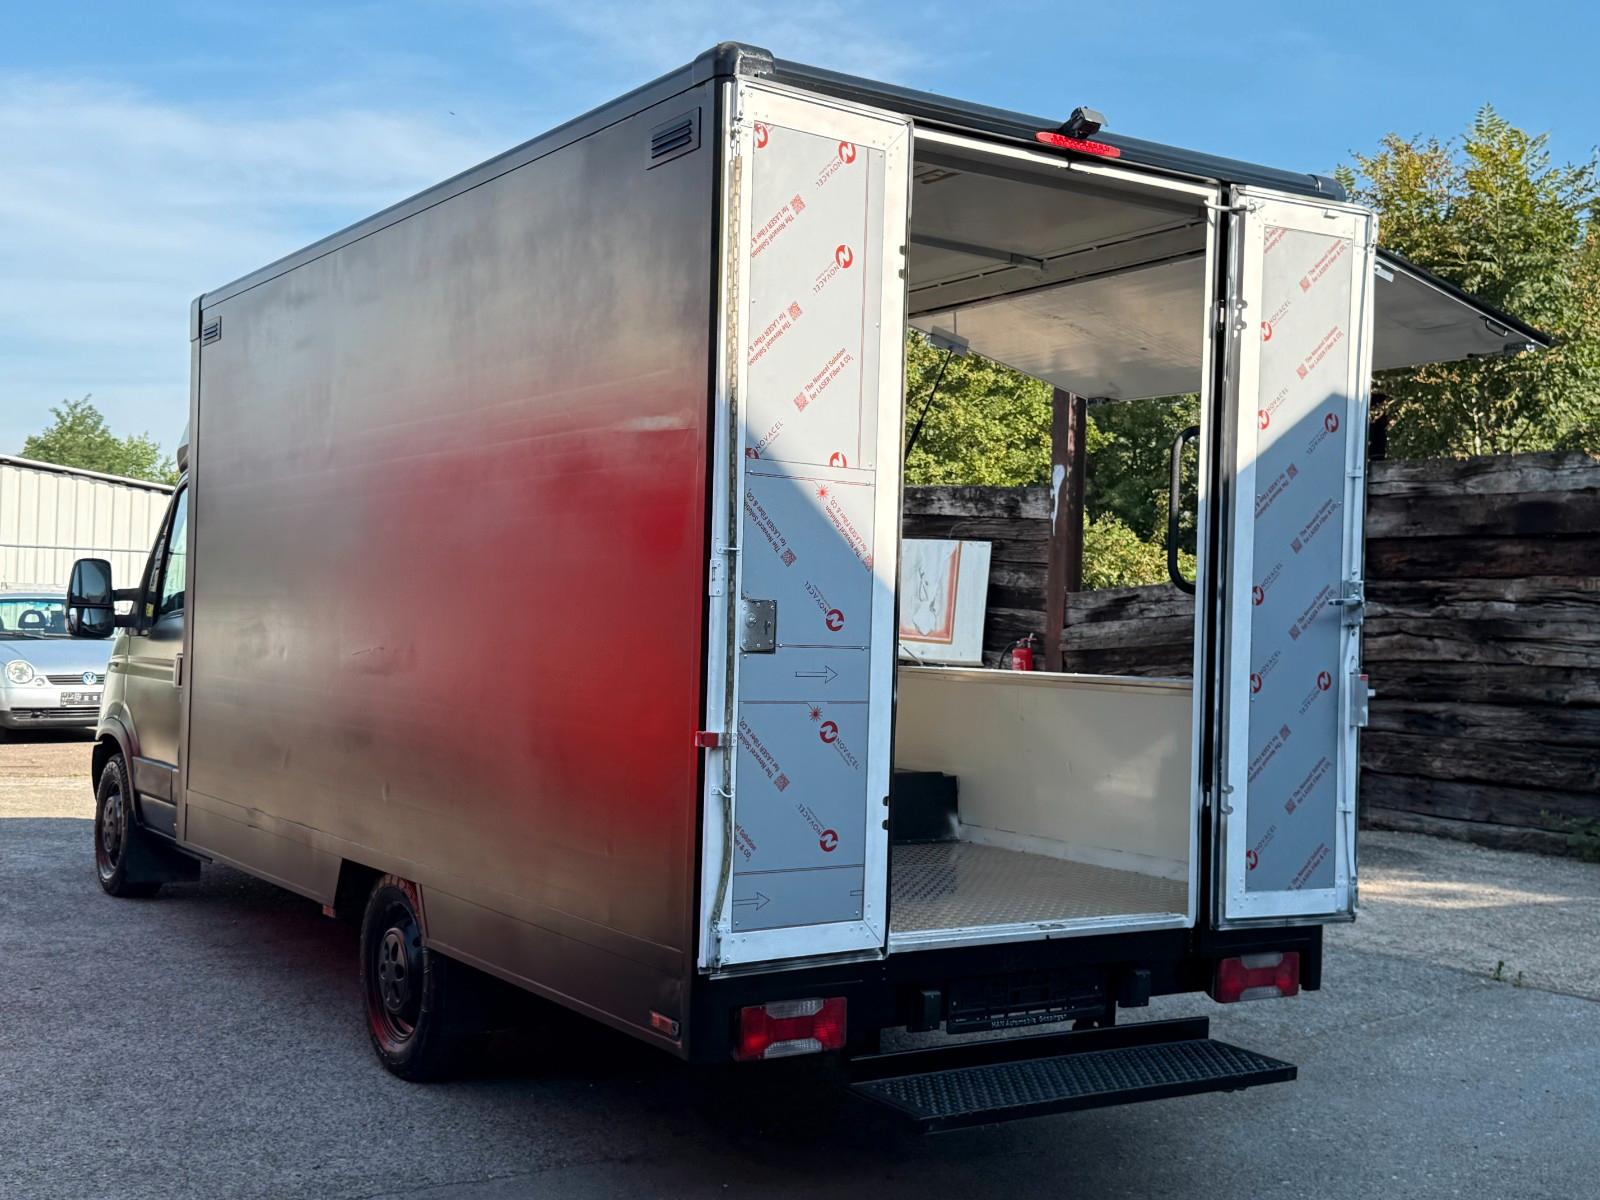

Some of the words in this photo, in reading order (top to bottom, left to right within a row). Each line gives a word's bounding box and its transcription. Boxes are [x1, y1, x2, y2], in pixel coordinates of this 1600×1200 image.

[813, 264, 840, 293] NOVACEL
[816, 376, 830, 394] LASER
[755, 419, 784, 451] NOVACEL
[804, 580, 829, 614] NOVACEL
[836, 738, 860, 770] NOVACEL
